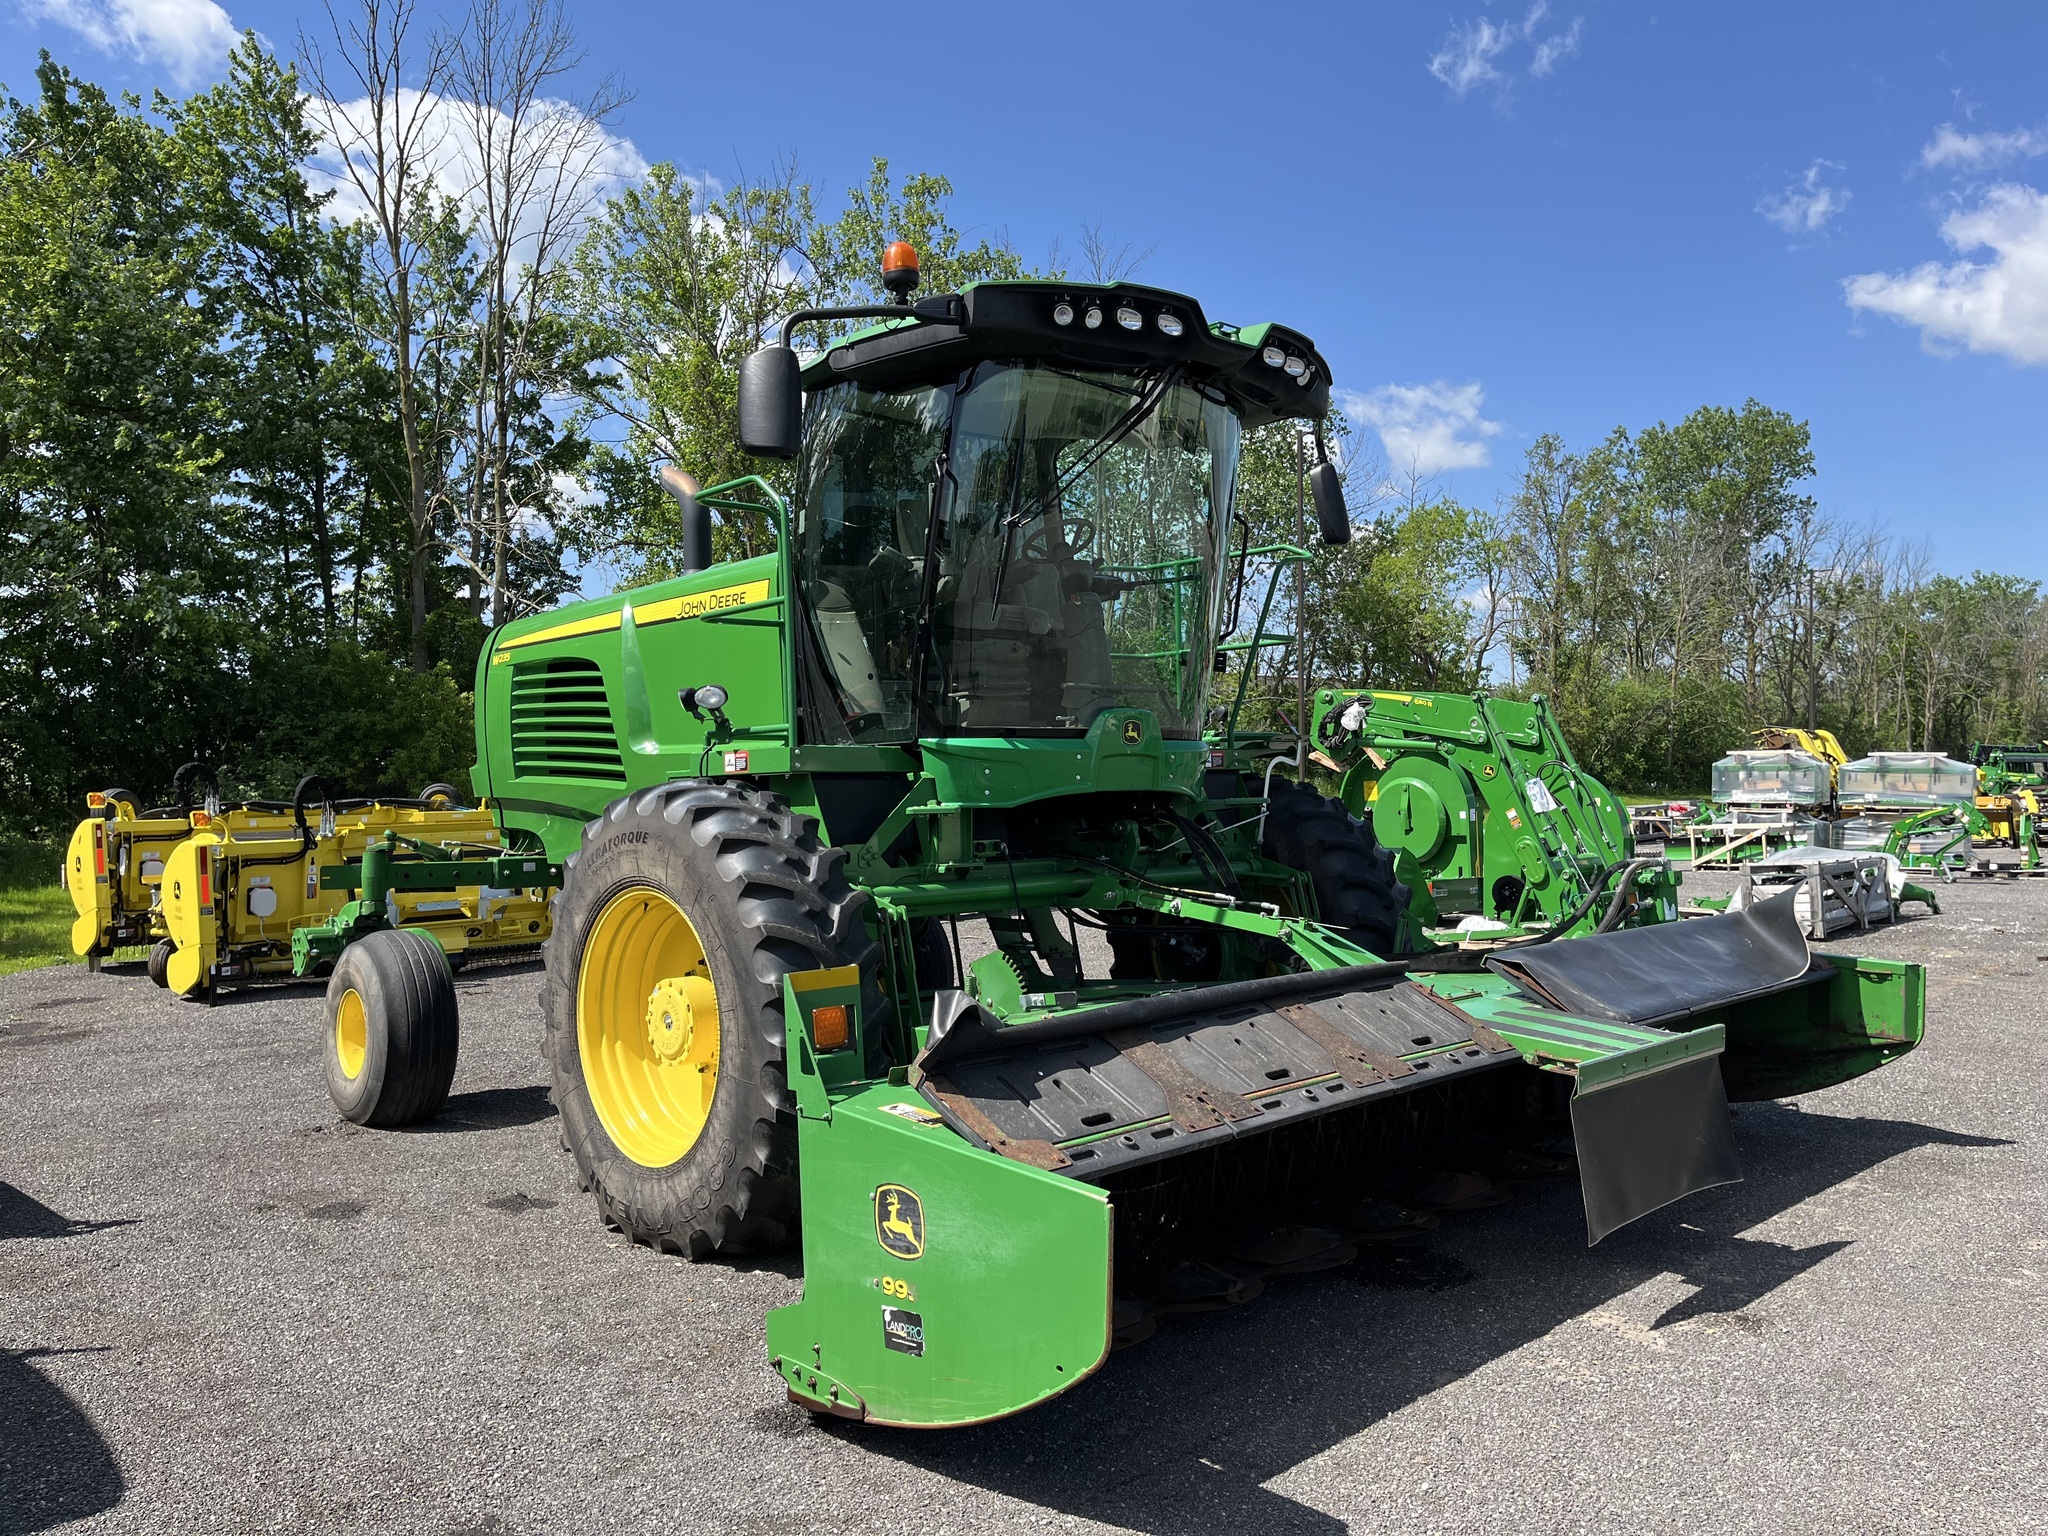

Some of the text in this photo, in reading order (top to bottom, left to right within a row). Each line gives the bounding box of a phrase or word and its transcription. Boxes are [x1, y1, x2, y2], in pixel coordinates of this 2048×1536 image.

[677, 592, 747, 616] JOHN DEERE
[885, 1320, 923, 1340] LANDPRO
